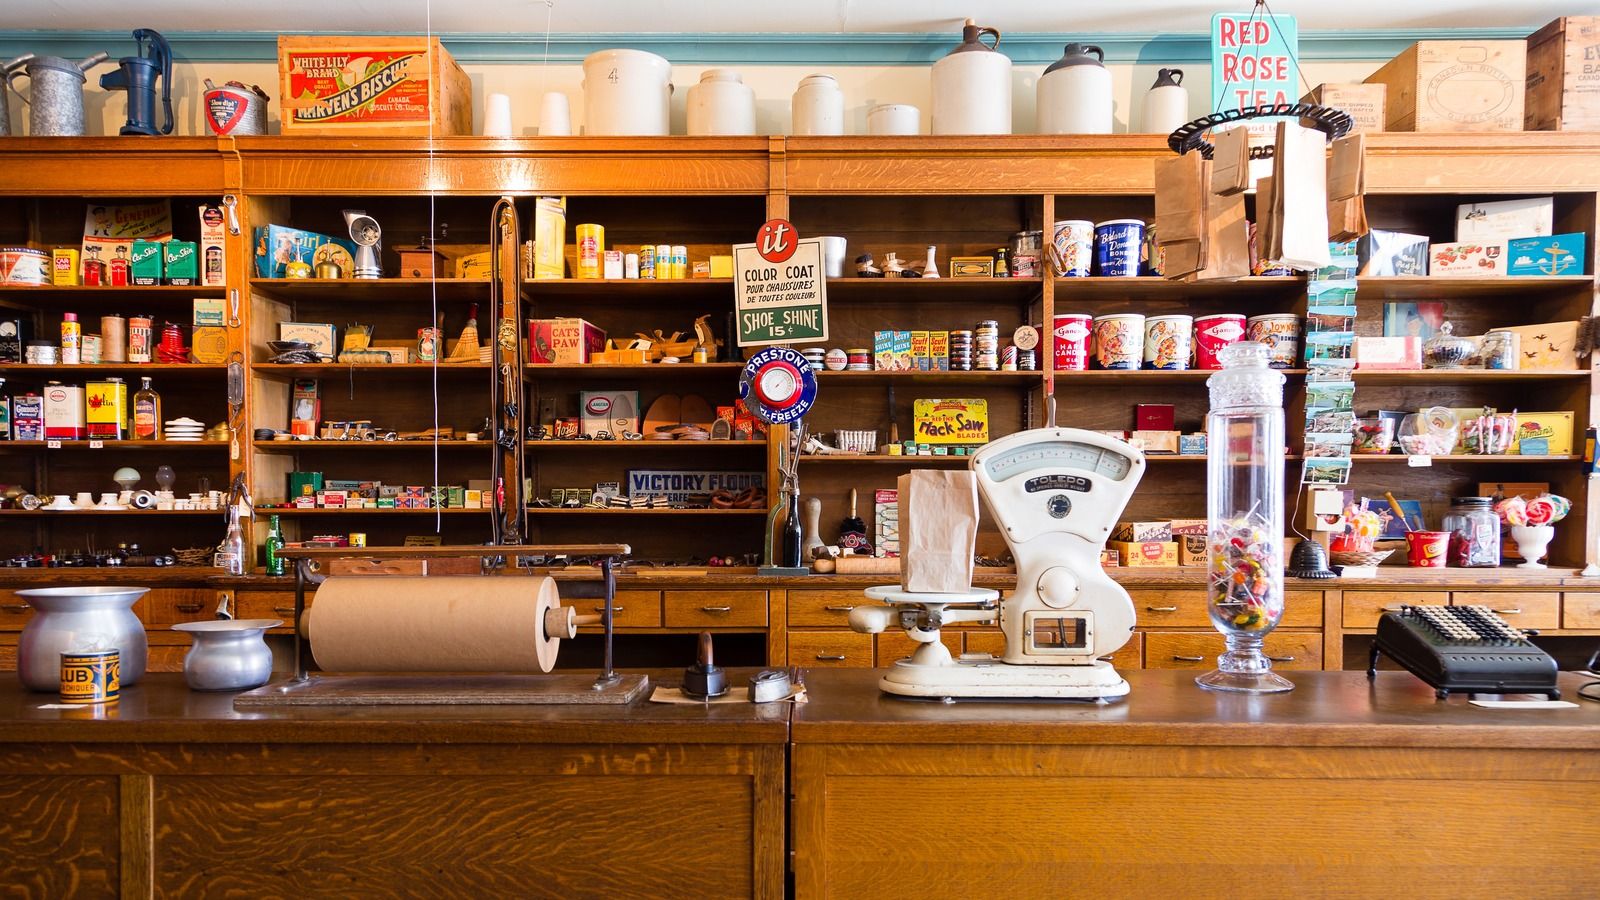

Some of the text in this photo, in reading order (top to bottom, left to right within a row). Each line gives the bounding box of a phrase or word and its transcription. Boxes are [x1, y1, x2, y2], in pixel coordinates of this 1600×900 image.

[1220, 18, 1270, 46] RED
[293, 56, 348, 69] WHITE LILY
[1224, 54, 1288, 82] ROSE
[306, 69, 339, 78] BRAND
[608, 68, 618, 82] 4
[1236, 90, 1287, 114] TEA
[762, 224, 789, 254] it
[745, 265, 814, 282] COLOR COAT
[746, 280, 815, 294] POUR CHAUSSURES
[759, 294, 783, 302] TOUTES
[785, 292, 816, 300] COULEURS
[744, 309, 819, 334] SHOE SHINE
[552, 328, 580, 337] CAT'S
[553, 338, 579, 348] PAW
[748, 350, 810, 374] PRESTONE
[760, 400, 808, 421] TI-FREEZE
[956, 413, 984, 432] Saw
[633, 474, 763, 490] VICTORY FLOUR
[1030, 476, 1086, 485] TOLEDO
[61, 670, 88, 682] LUB
